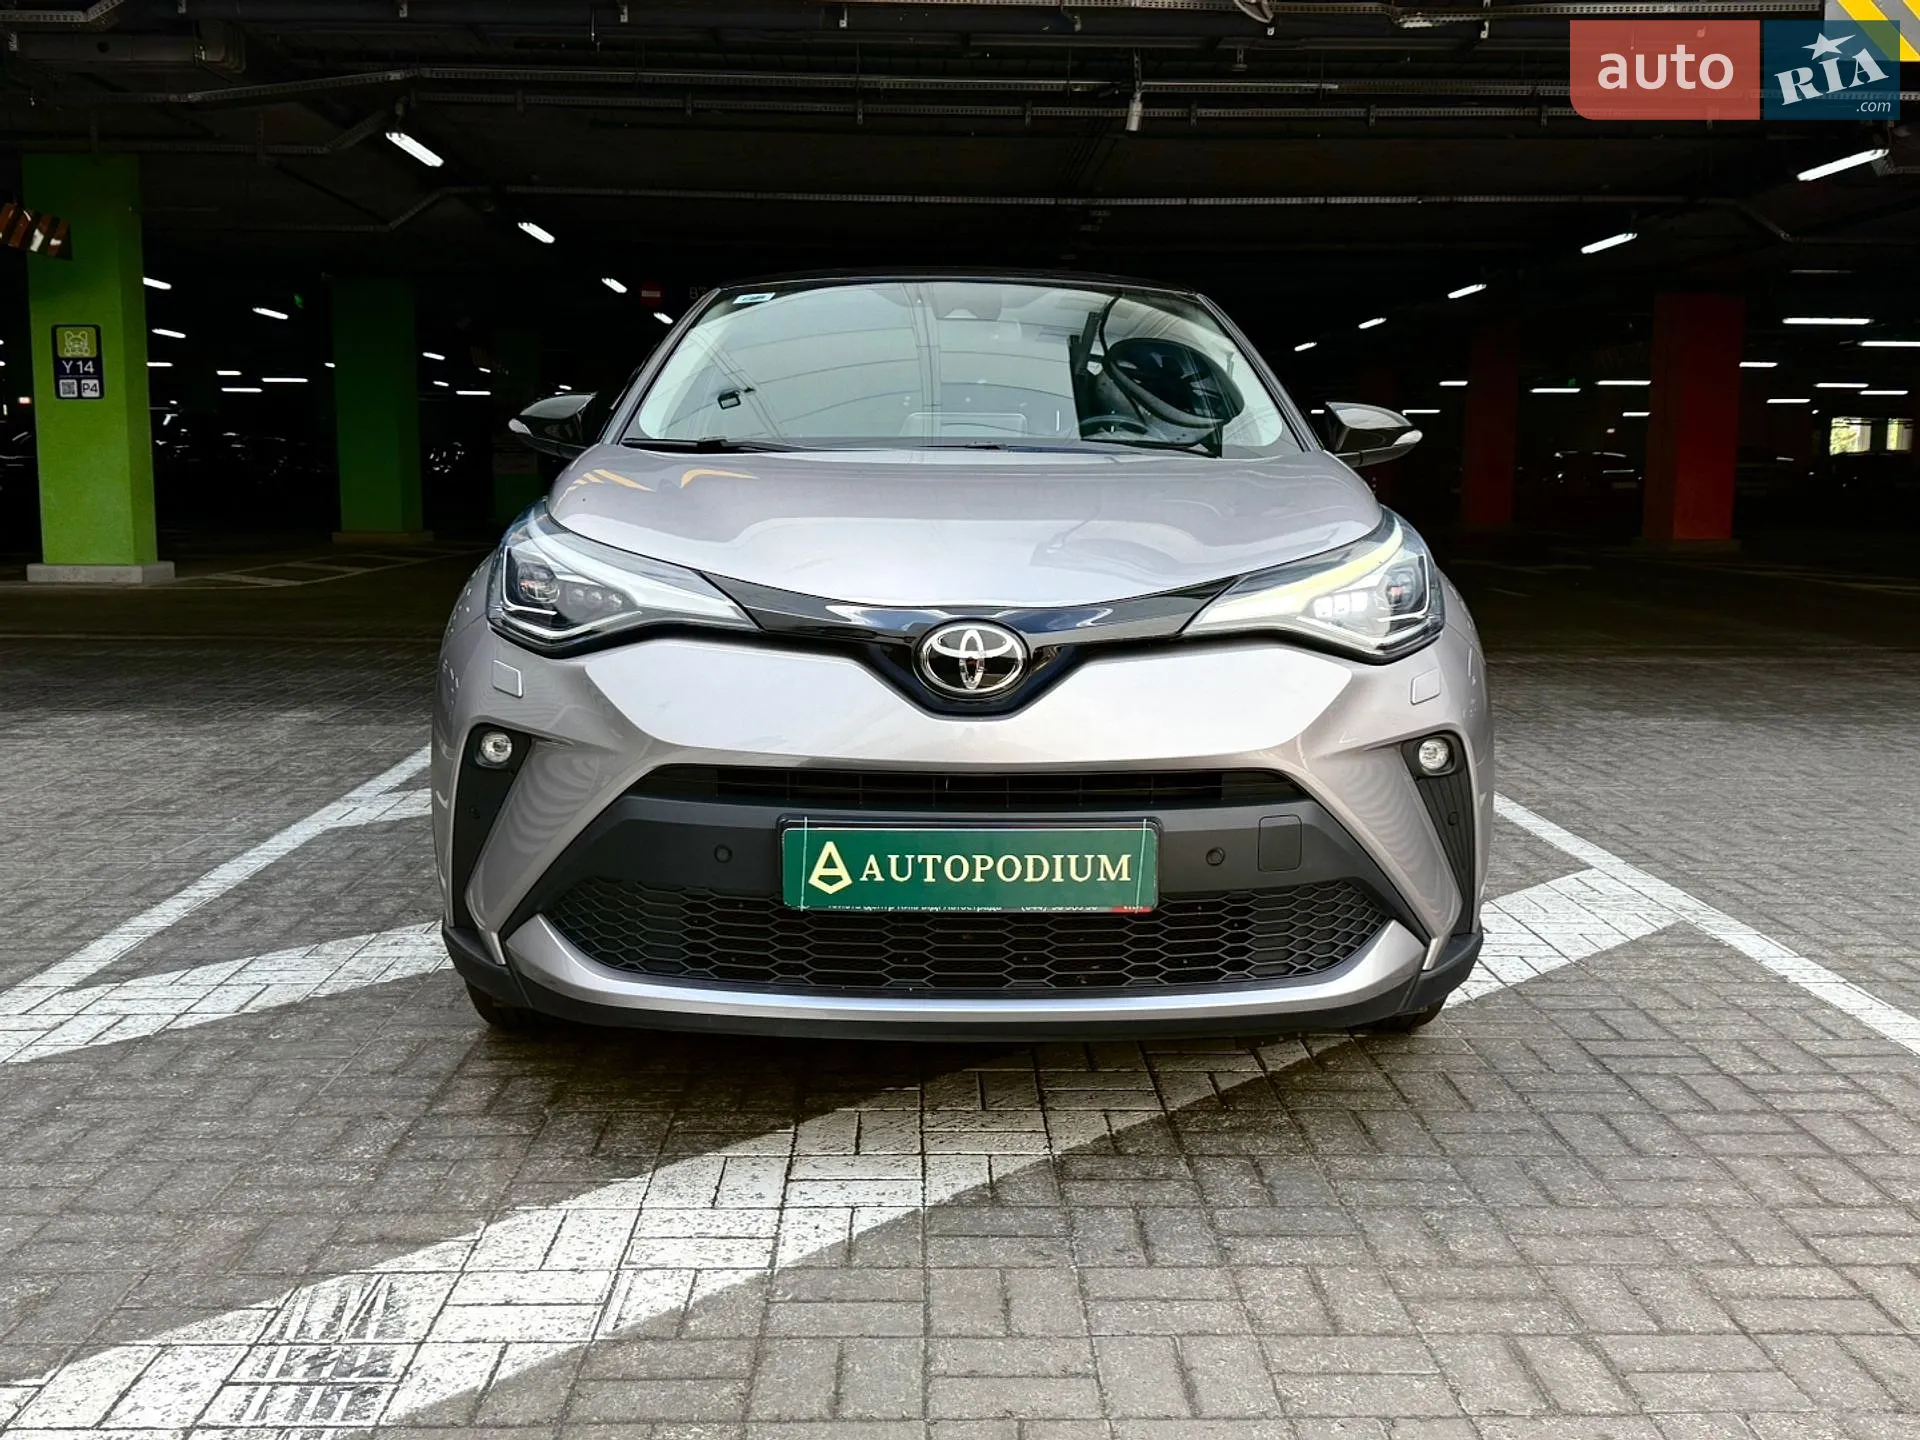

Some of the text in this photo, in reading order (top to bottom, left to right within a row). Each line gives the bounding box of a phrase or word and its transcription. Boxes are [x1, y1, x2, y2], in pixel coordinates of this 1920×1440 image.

[62, 360, 95, 374] Y 14
[82, 382, 98, 393] P4
[859, 854, 1132, 883] AUTOPODIUM
